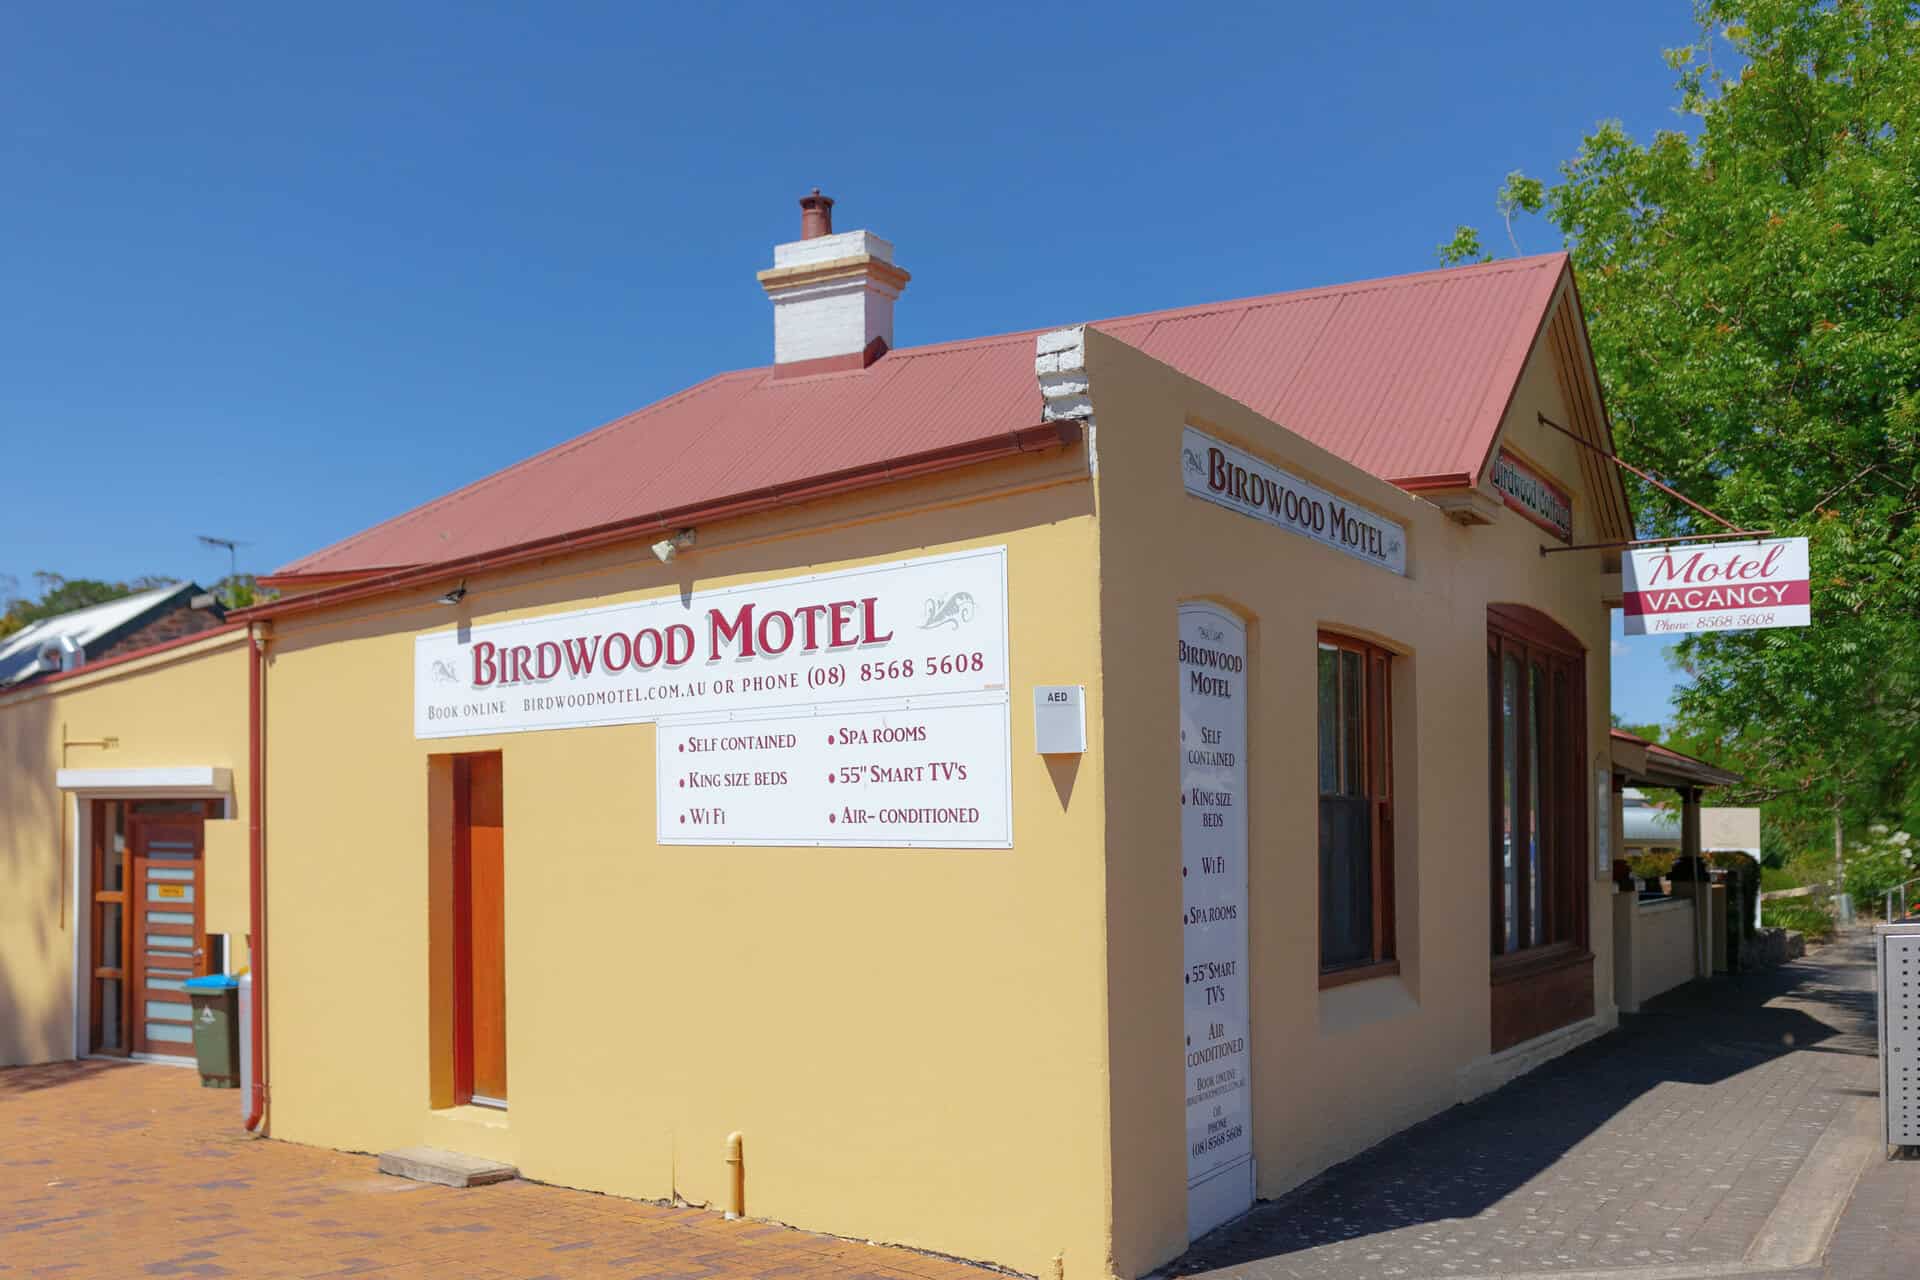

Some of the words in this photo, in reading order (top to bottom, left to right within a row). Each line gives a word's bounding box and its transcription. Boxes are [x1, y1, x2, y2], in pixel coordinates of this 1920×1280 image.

[1208, 447, 1325, 531] BIRDWOOD
[1329, 502, 1387, 560] MOTEL
[1648, 544, 1784, 586] Motel
[1646, 583, 1790, 611] VACANCY
[1696, 614, 1733, 628] 8568
[1737, 612, 1775, 626] 5608
[472, 623, 695, 687] BIRDWOOD
[707, 597, 893, 661] MOTEL
[1178, 640, 1242, 673] BIRDWOOD
[428, 704, 458, 721] BOOK
[463, 700, 507, 718] ONLINE
[523, 681, 706, 712] BIRDWOODMOTEL.COM.AU
[713, 679, 735, 694] OR
[742, 673, 799, 692] PHONE
[807, 664, 846, 689] (08)
[860, 658, 914, 683] 8568
[925, 652, 984, 676] 5608
[1190, 670, 1231, 699] MOTEL
[1047, 691, 1068, 703] AED
[688, 736, 717, 753] SELF
[720, 733, 796, 751] CONTAINED
[839, 727, 868, 745] SPA
[873, 726, 926, 743] ROOMS
[1201, 726, 1222, 745] SELF
[1188, 750, 1235, 767] CONTAINED
[689, 771, 721, 788] KING
[724, 771, 750, 787] SIZE
[754, 770, 788, 786] BEDS
[839, 765, 867, 784] 55"
[870, 764, 924, 783] SMART
[1192, 787, 1214, 807] KING
[1215, 792, 1232, 807] SIZE
[841, 806, 876, 824] AIR-
[879, 807, 979, 824] CONDITIONED
[1202, 812, 1223, 828] BEDS
[1190, 905, 1207, 924] SPA
[1209, 904, 1237, 921] ROOMS
[1208, 960, 1236, 980] SMART
[1208, 1022, 1224, 1040] AIR
[1187, 1037, 1243, 1068] CONDITIONED
